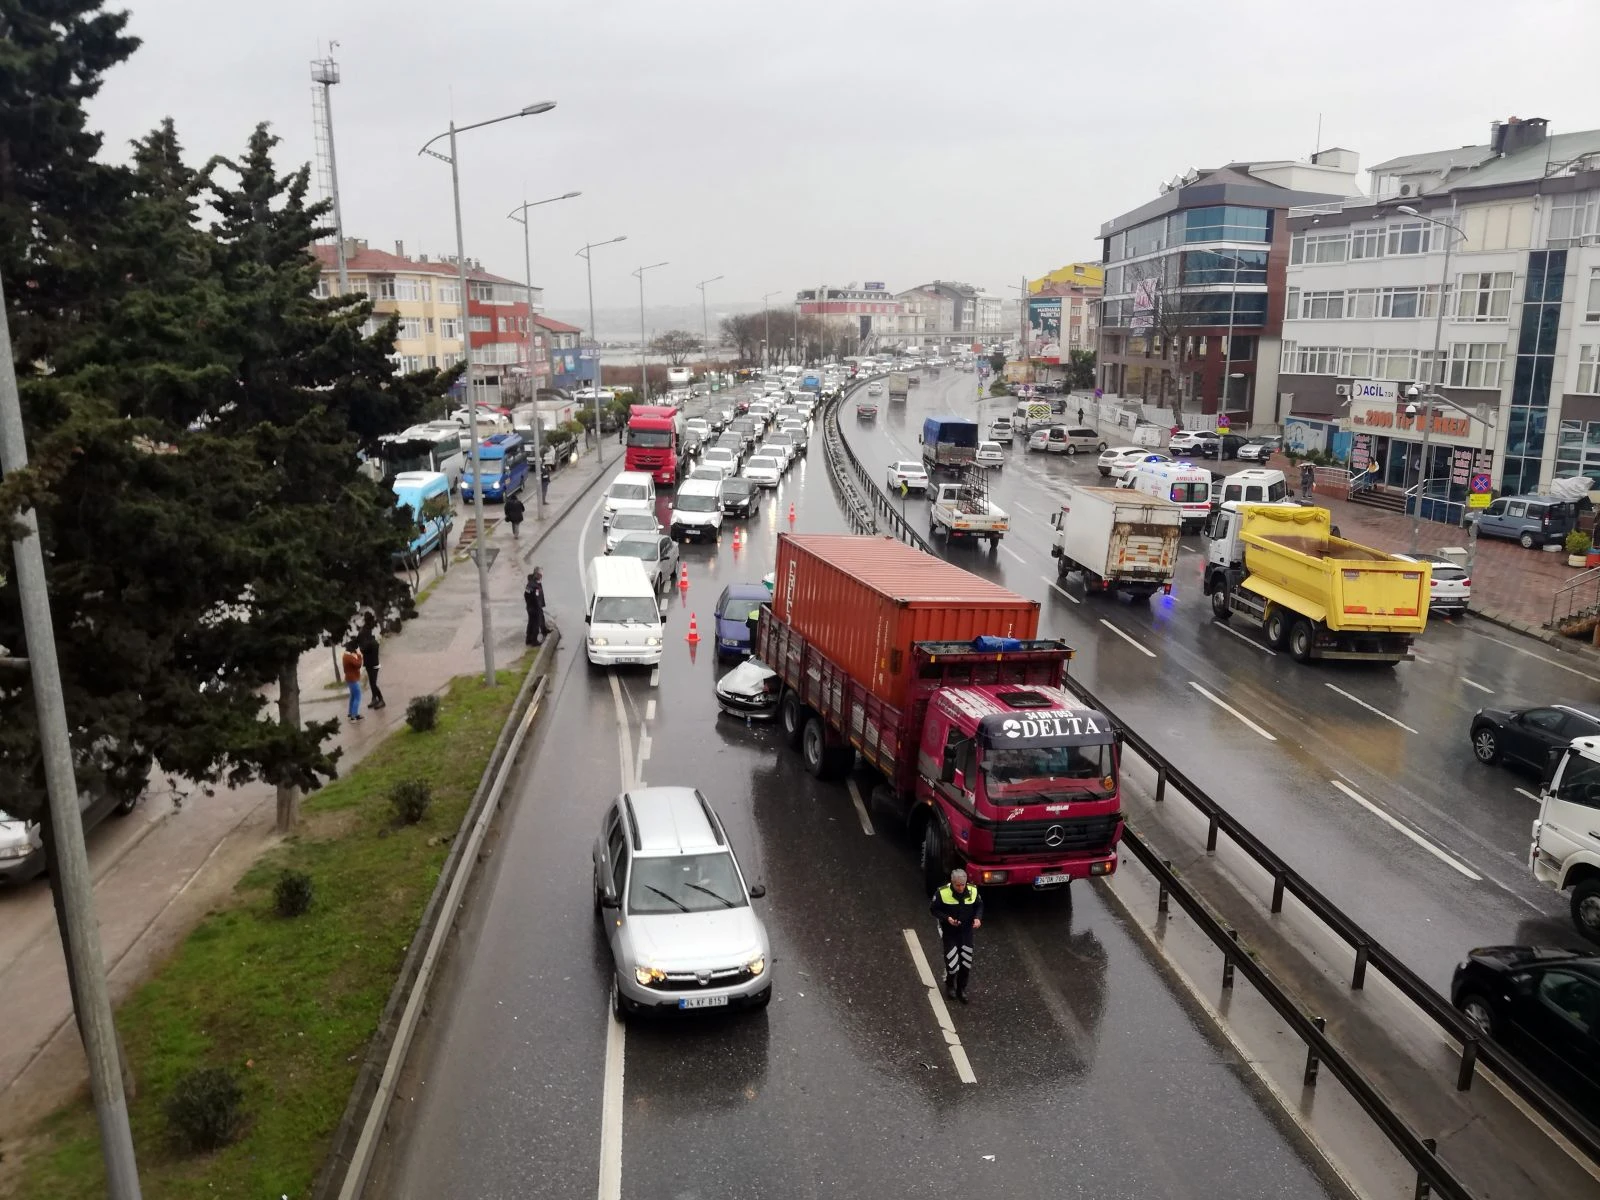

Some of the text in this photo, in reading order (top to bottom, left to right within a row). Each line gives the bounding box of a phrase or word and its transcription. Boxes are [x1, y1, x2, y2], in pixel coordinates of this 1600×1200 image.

[1363, 384, 1384, 397] ACİL
[1025, 712, 1038, 720] 34
[1020, 717, 1101, 738] DELTA
